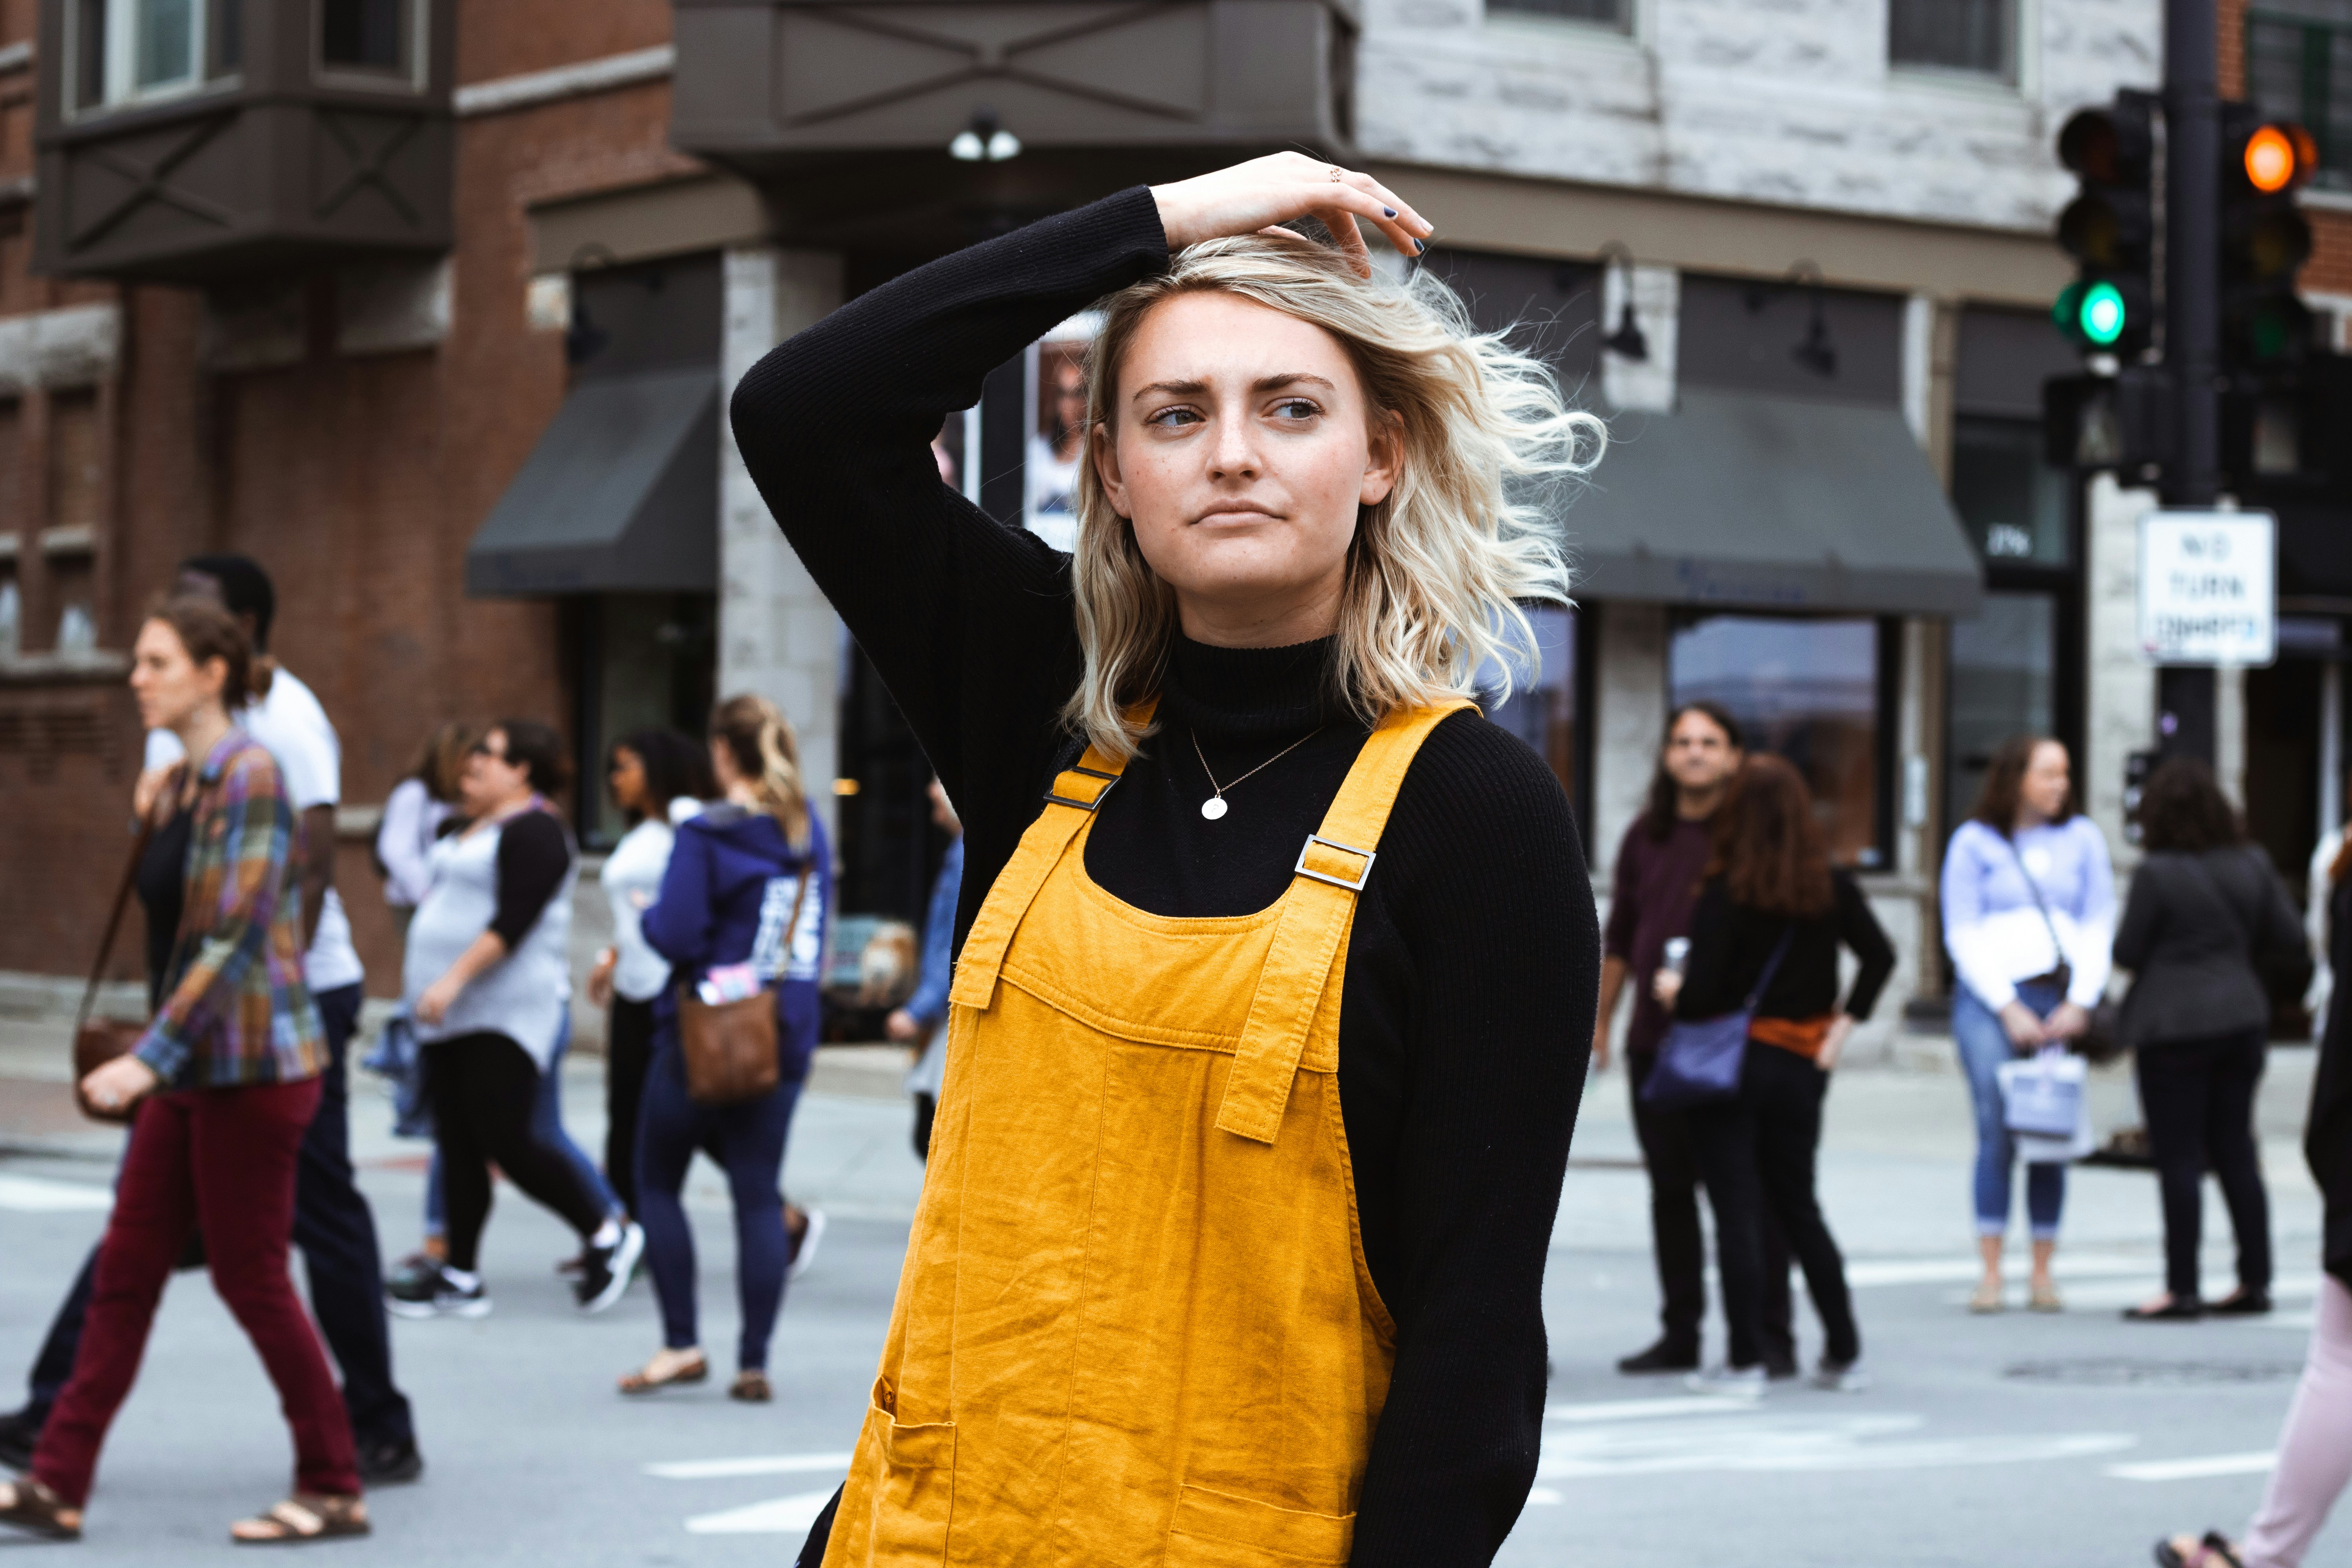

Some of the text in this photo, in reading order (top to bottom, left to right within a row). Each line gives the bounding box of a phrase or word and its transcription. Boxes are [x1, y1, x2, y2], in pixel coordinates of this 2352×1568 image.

[2181, 533, 2232, 561] NO
[2169, 570, 2246, 599] TURN
[1212, 804, 1219, 813] P
